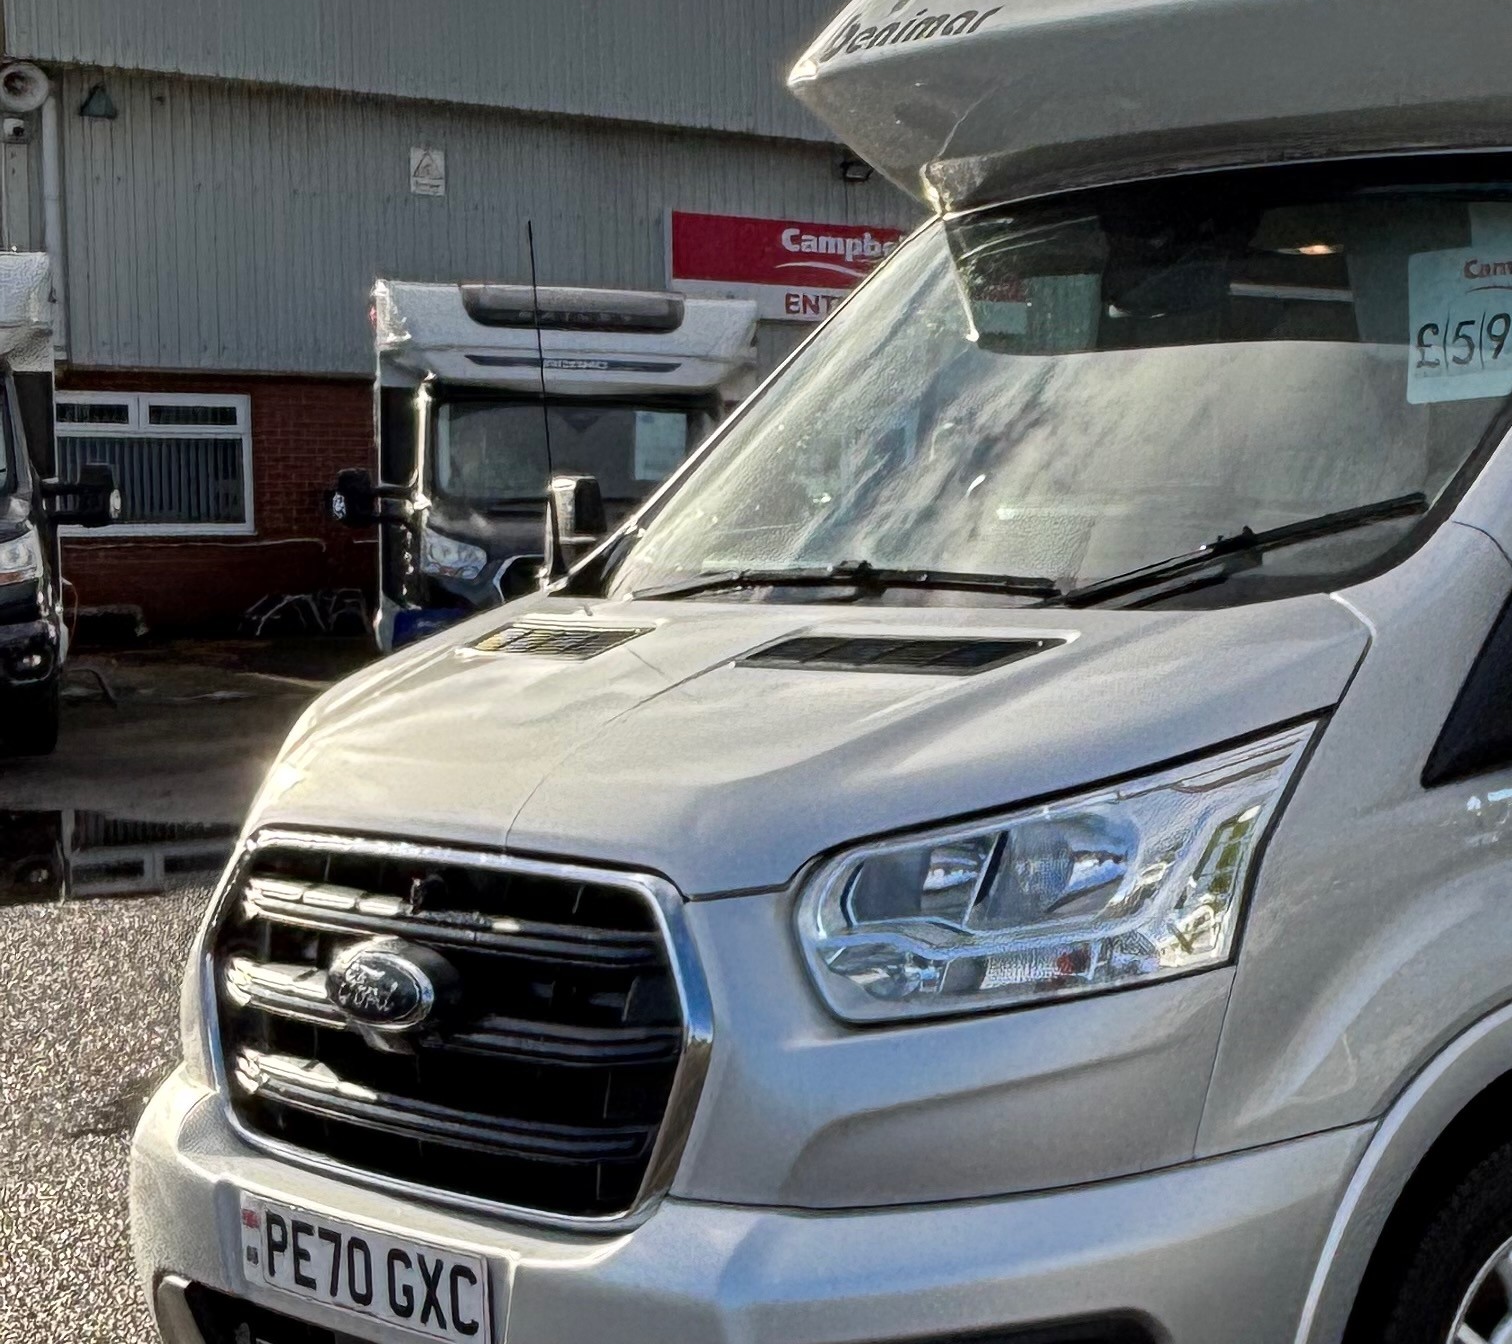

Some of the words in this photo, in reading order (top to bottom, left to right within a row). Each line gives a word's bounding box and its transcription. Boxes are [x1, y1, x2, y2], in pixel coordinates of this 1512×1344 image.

[781, 227, 903, 262] Campbe
[784, 292, 845, 315] ENT
[265, 1210, 374, 1306] PE70
[387, 1247, 480, 1336] GXC
